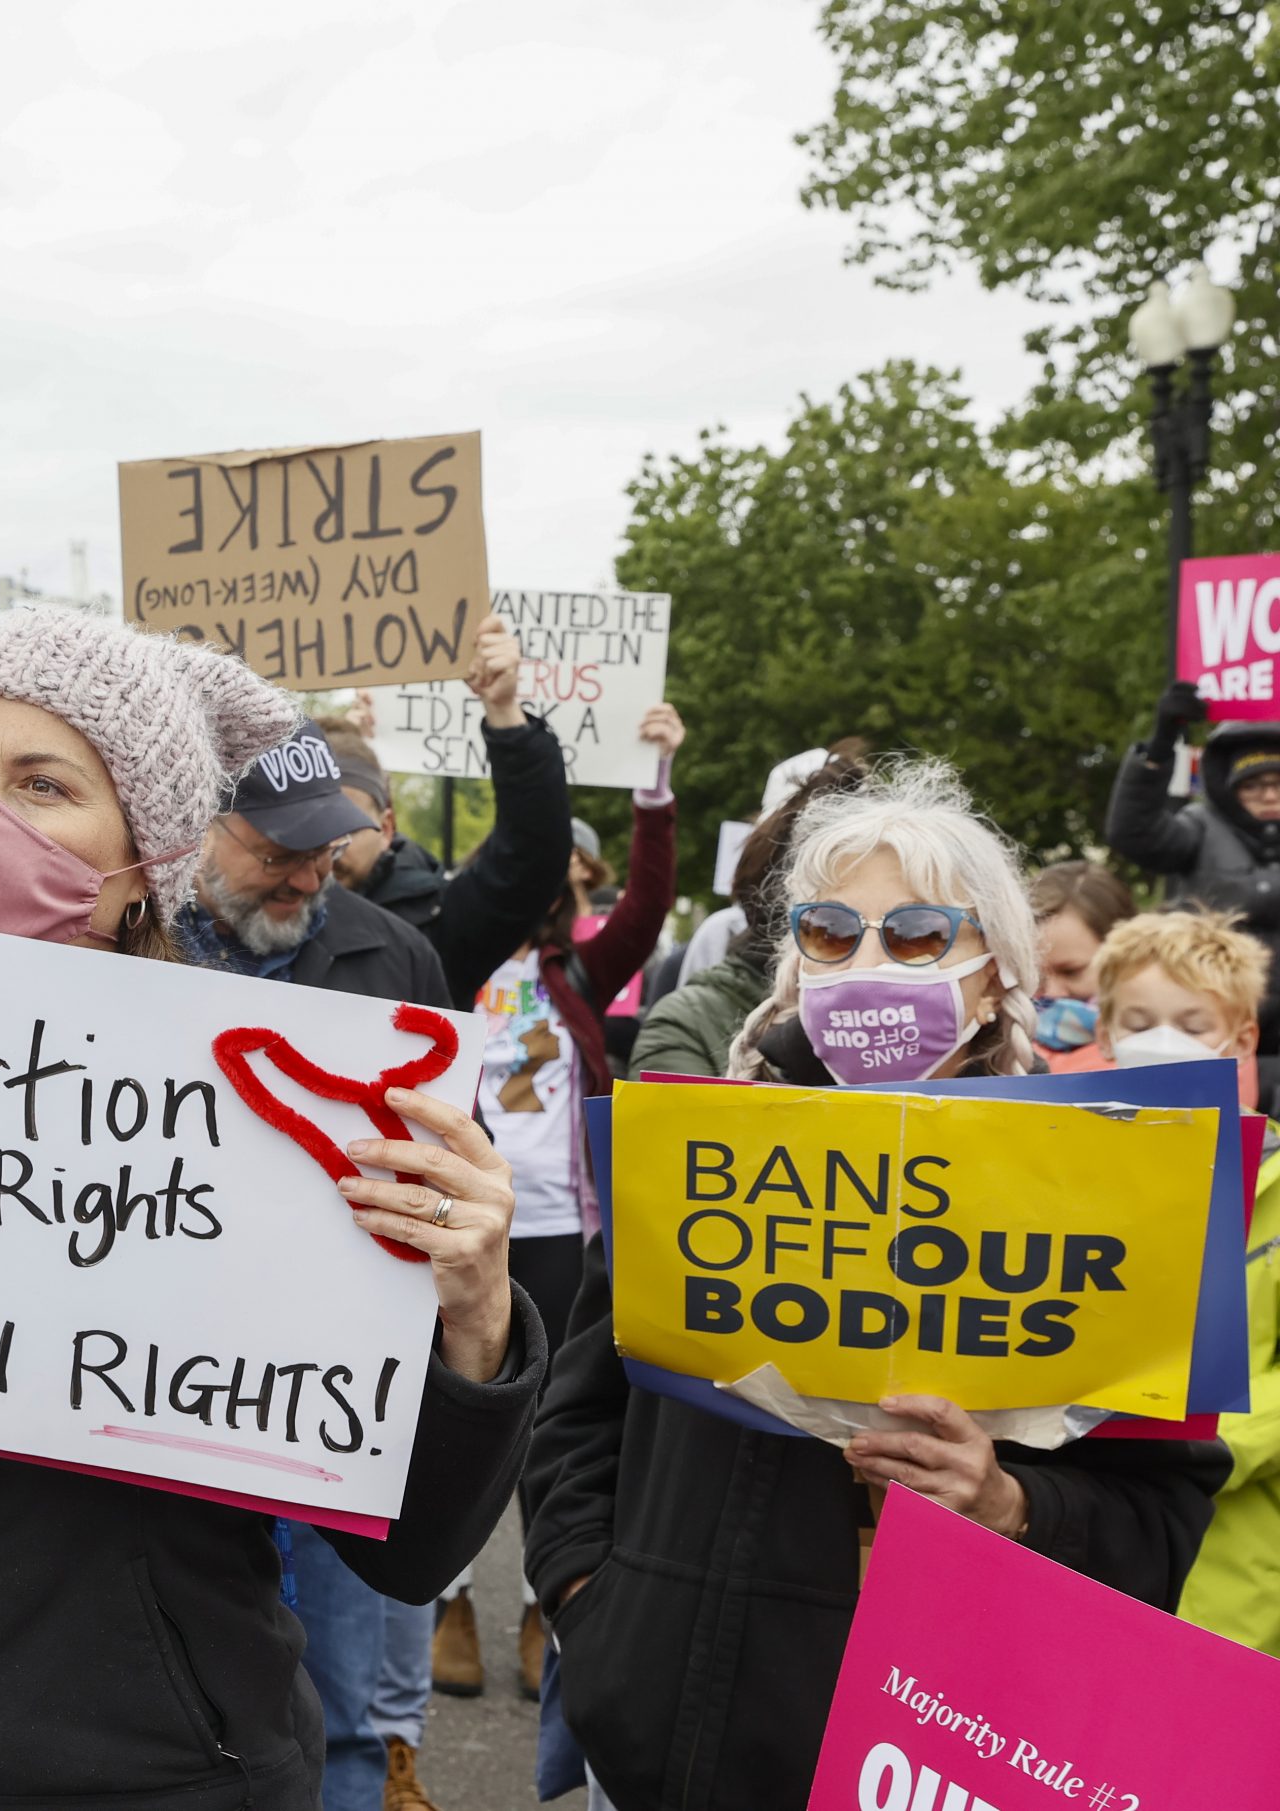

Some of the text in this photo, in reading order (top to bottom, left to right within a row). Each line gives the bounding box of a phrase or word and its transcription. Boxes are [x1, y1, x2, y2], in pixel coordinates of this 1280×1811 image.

[167, 446, 459, 554] STRIKE
[135, 549, 420, 622] DAY (WEEK-LONG)
[491, 590, 667, 633] ANTED THE
[595, 630, 642, 665] IN
[1195, 658, 1274, 702] ARE
[575, 705, 600, 744] A
[821, 1025, 921, 1049] OFF OUR
[828, 1004, 917, 1029] BODIES
[861, 1042, 920, 1069] BANS
[684, 1139, 952, 1219] BANS
[676, 1208, 1127, 1293] OFF OUR
[684, 1275, 1081, 1359] BODIES
[69, 1329, 402, 1457] RIGHTS!
[879, 1664, 1007, 1760] Majority
[1006, 1737, 1085, 1799] Rule
